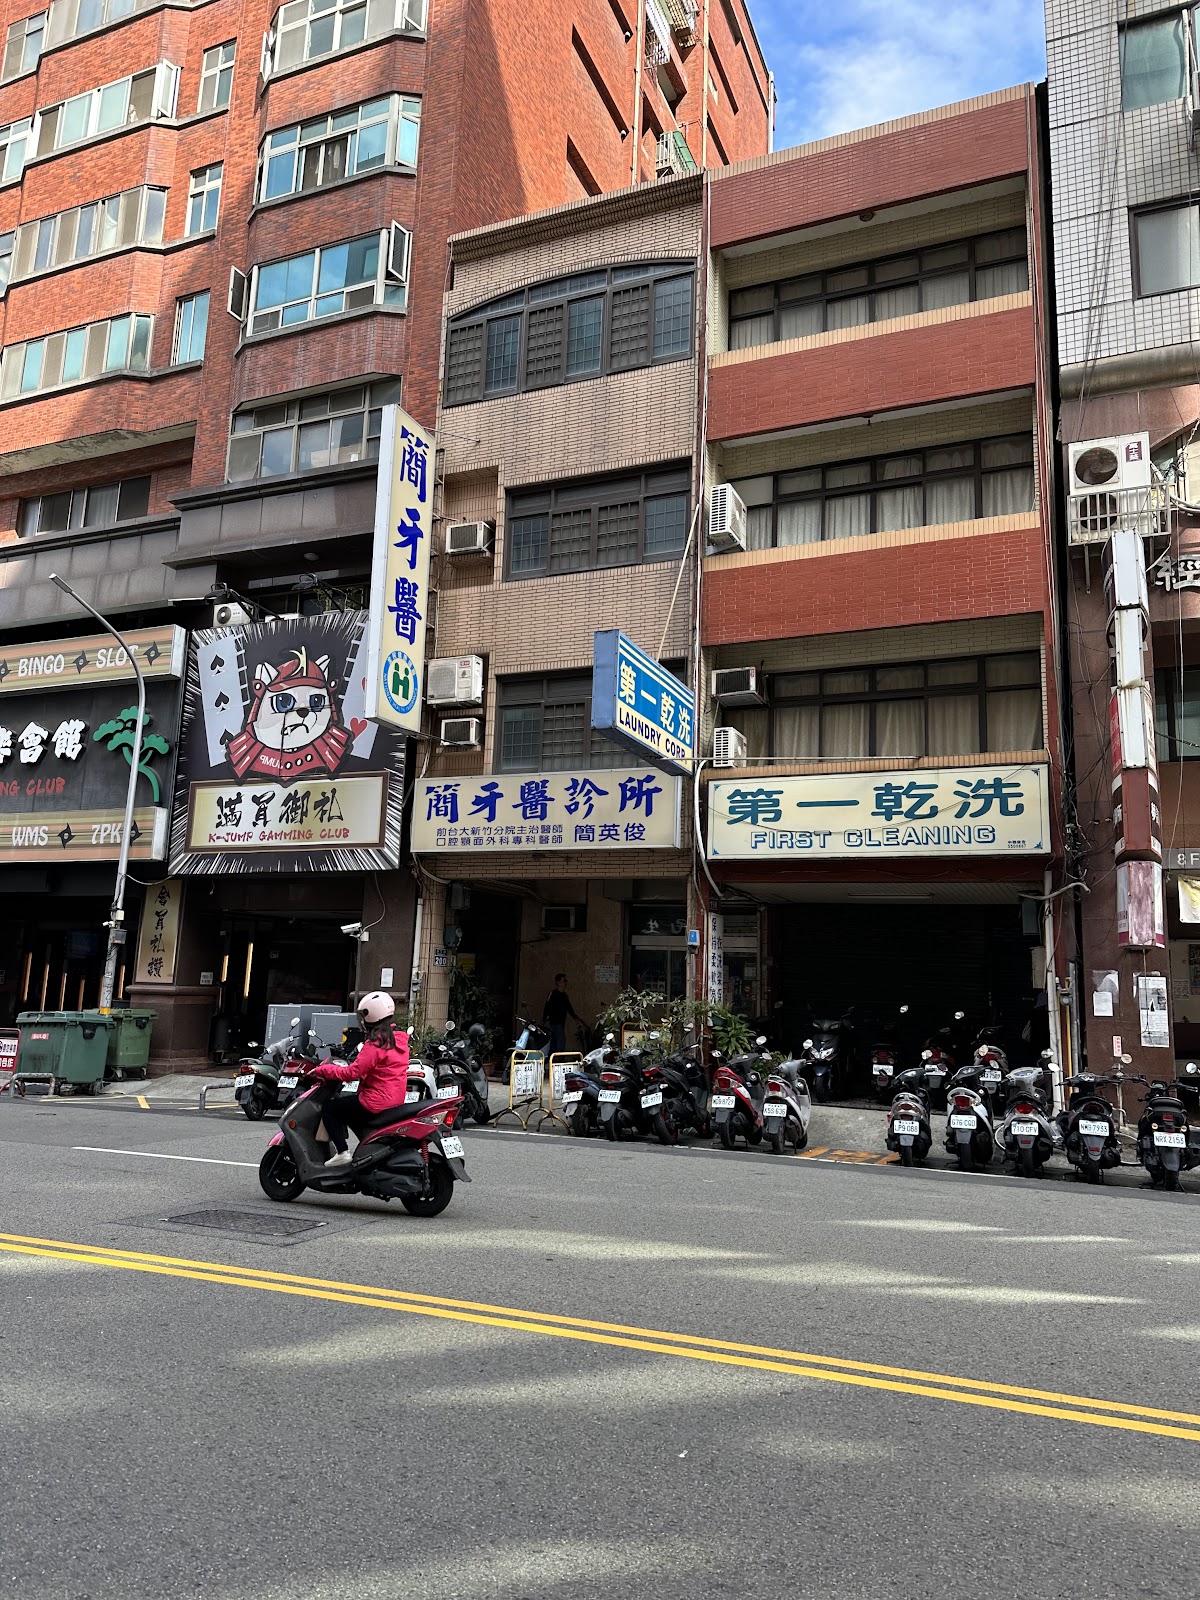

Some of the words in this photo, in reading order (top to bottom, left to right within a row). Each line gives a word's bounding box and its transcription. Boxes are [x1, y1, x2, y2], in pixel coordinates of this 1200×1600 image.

[387, 425, 429, 646] 簡牙醫
[18, 654, 65, 677] BINGO
[96, 644, 139, 669] SLOT
[619, 660, 691, 745] 第一乾洗
[619, 707, 662, 747] LAUNDRY
[26, 776, 65, 796] CLUB
[425, 774, 663, 824] 簡牙醫診所
[726, 777, 1024, 825] 第一乾洗
[12, 825, 48, 847] WMS
[91, 822, 122, 845] 7PK
[208, 831, 253, 843] K-JUMP
[259, 829, 314, 841] GAMMING
[319, 827, 350, 839] CLUB
[574, 822, 647, 843] 簡英俊
[750, 830, 831, 850] FIRST
[843, 825, 996, 847] CLEANING
